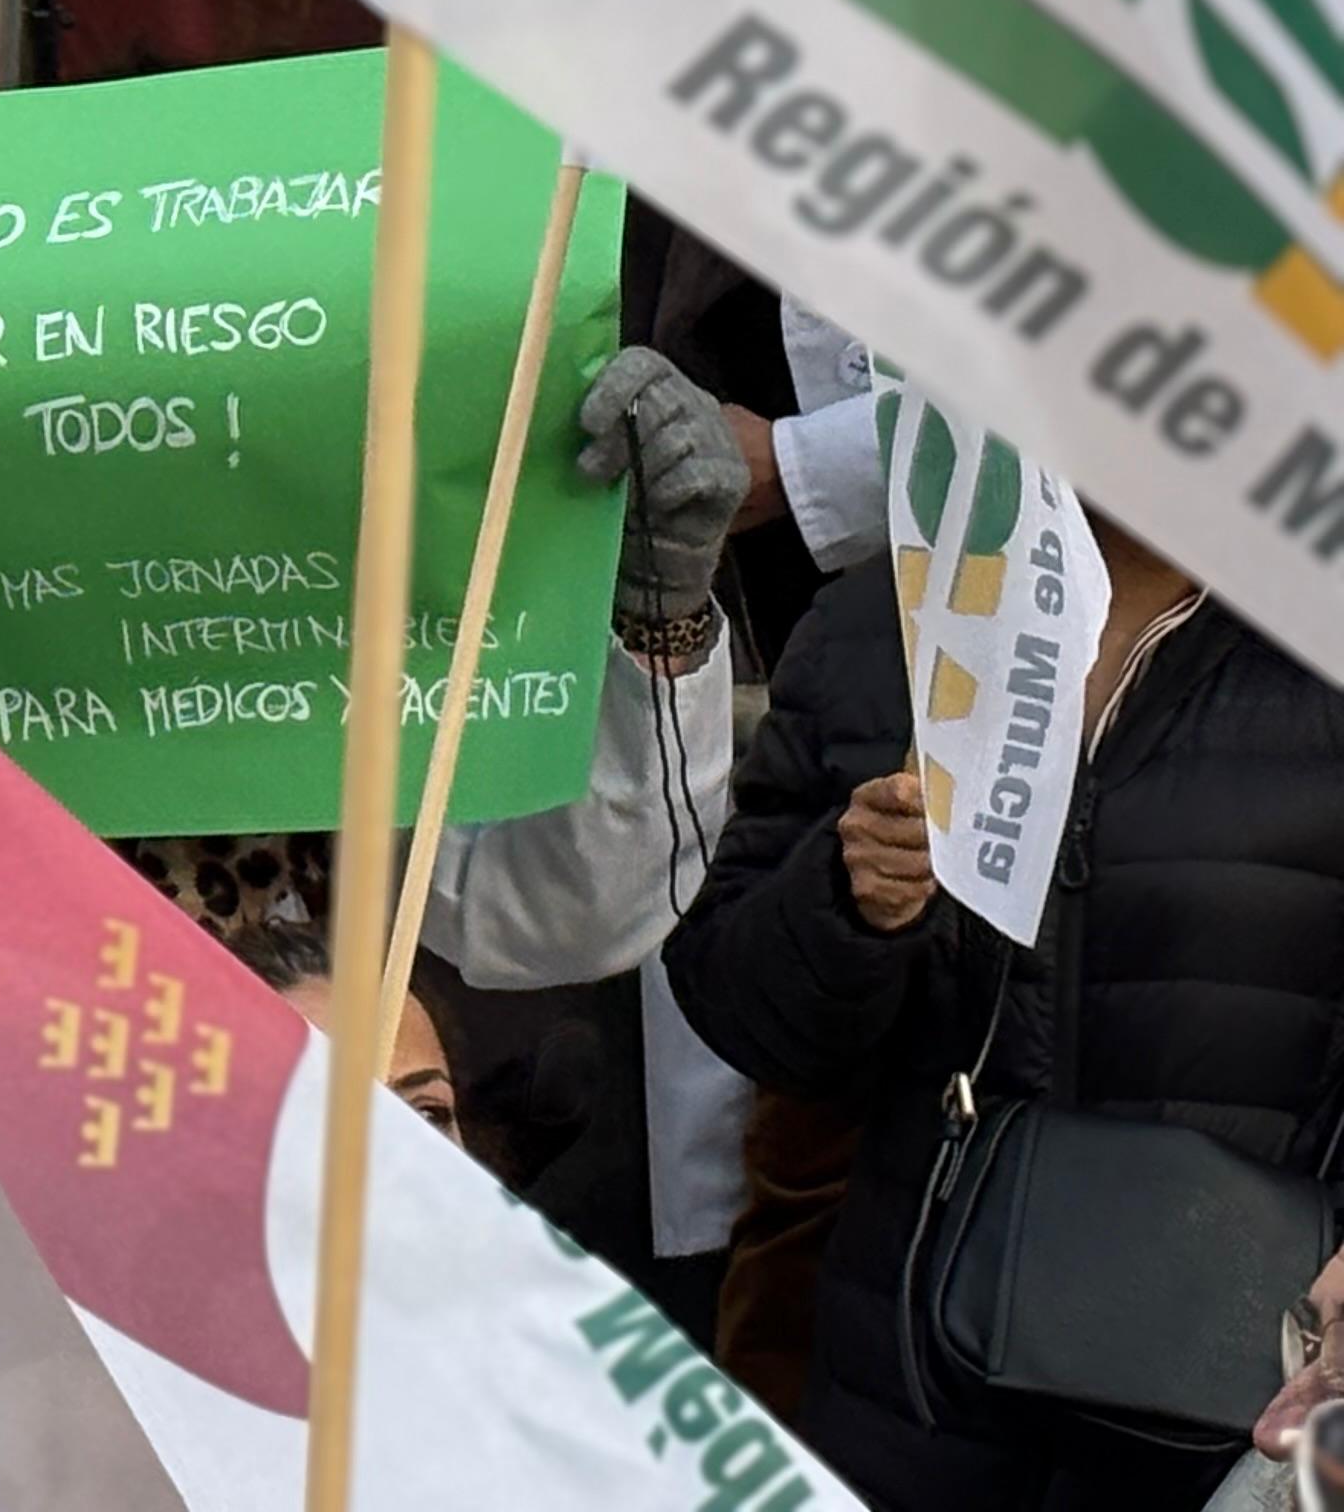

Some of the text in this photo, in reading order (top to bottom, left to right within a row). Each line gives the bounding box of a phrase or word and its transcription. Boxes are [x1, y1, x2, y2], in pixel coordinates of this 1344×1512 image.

[46, 191, 123, 244] ES
[140, 167, 386, 233] TRABAJAR
[667, 13, 1090, 343] Región
[1089, 318, 1247, 460] de
[36, 305, 105, 362] EN
[135, 298, 327, 356] RIESGO
[23, 394, 196, 456] TODOS
[0, 563, 85, 611] MAS
[106, 551, 341, 599] JORNADAS
[140, 674, 318, 738] MÉDICOS
